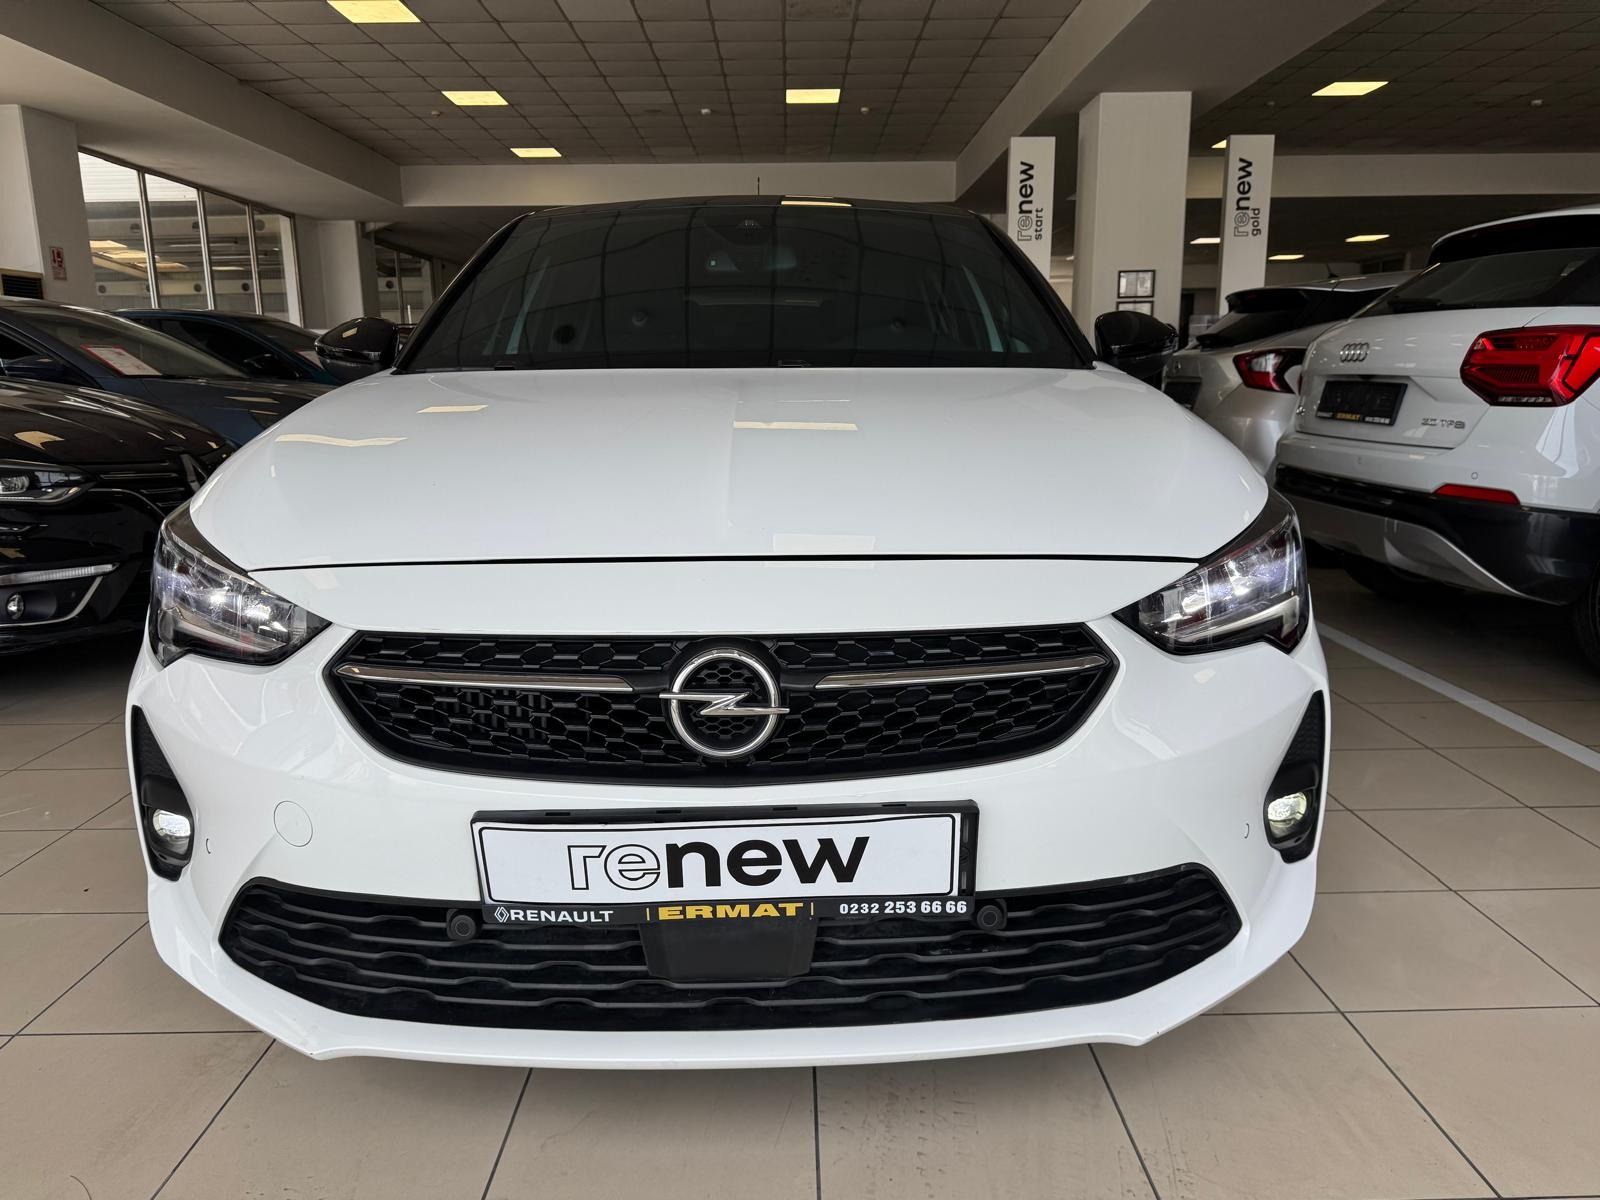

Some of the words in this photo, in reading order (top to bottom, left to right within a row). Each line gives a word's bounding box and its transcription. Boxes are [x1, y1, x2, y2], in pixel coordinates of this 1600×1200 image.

[1017, 161, 1035, 241] renew
[1234, 157, 1253, 237] renew
[1034, 207, 1043, 240] start
[1251, 207, 1261, 237] gold
[567, 836, 870, 891] renew
[509, 909, 614, 922] RENAULT
[658, 902, 803, 920] ERMAT
[839, 903, 879, 914] 0232
[884, 901, 917, 914] 253
[920, 901, 942, 914] 66
[945, 900, 967, 913] 66
